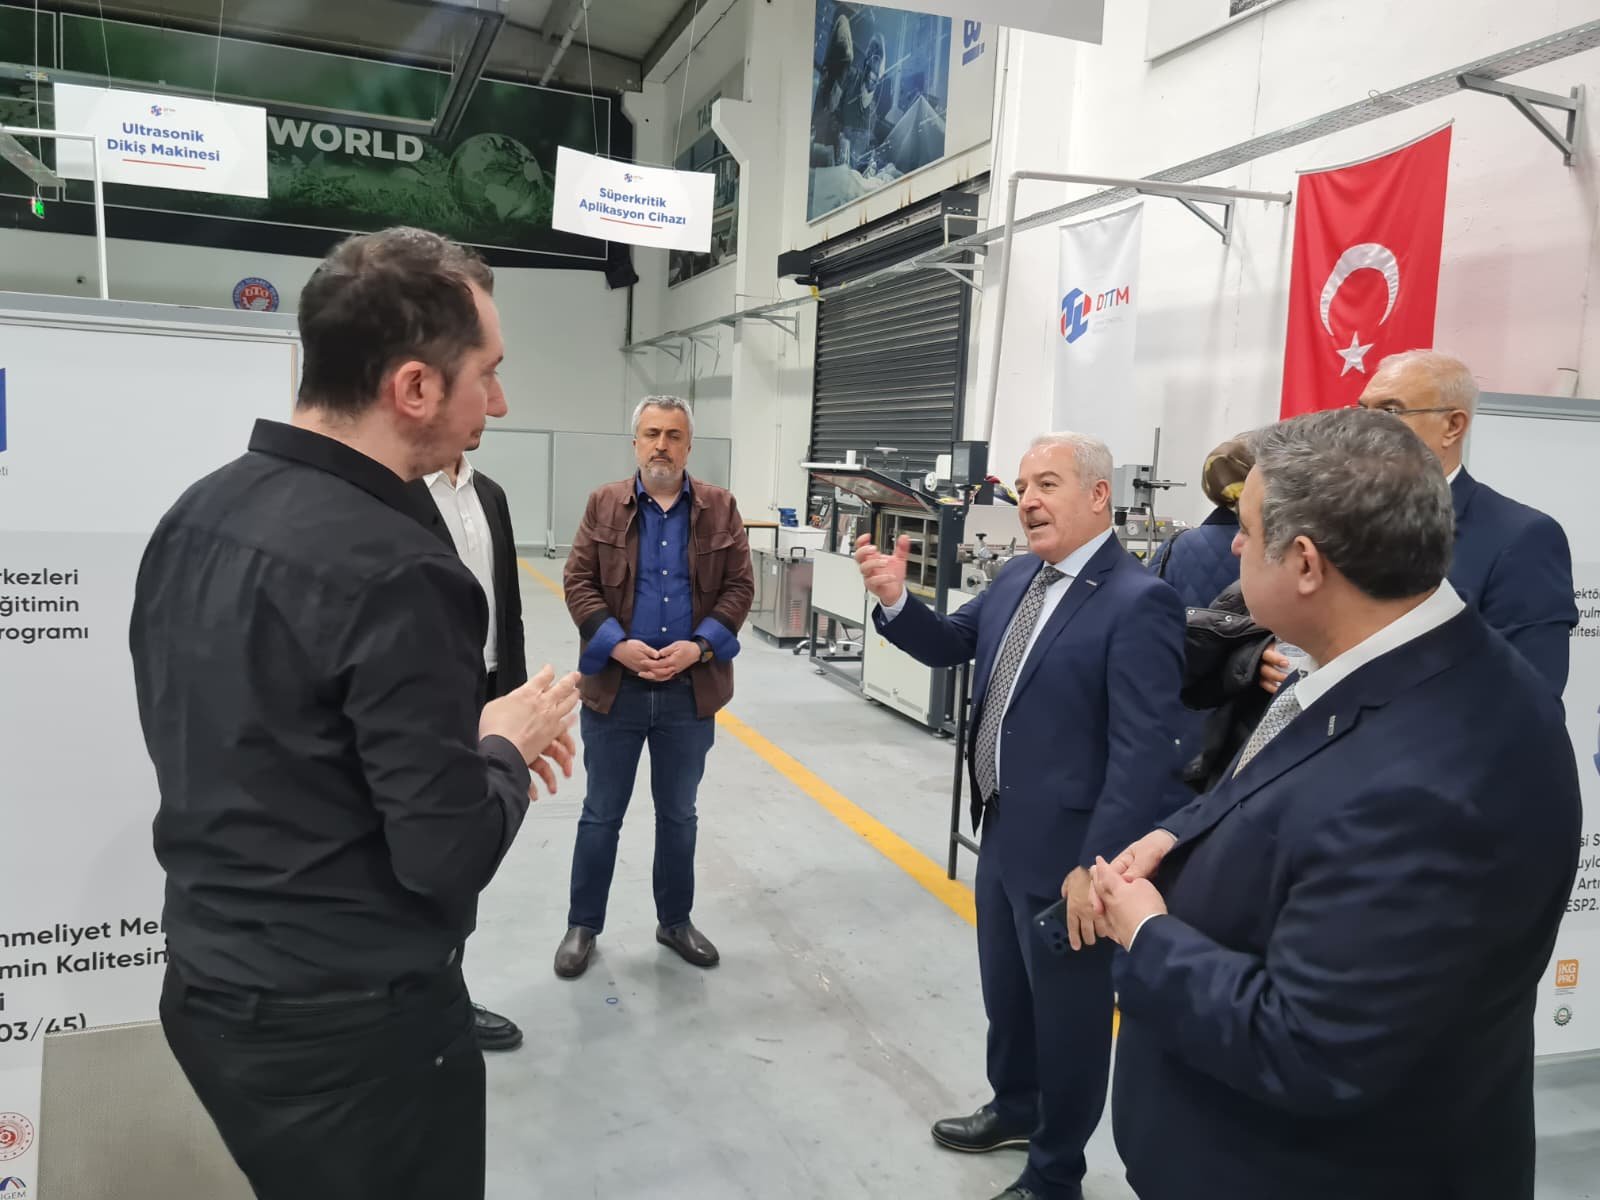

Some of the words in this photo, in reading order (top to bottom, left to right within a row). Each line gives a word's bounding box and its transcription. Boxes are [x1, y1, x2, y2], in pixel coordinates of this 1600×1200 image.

[122, 122, 204, 142] Ultrasonik
[267, 116, 424, 163] WORLD
[107, 138, 146, 155] Dikiş
[151, 143, 220, 161] Makinesi
[600, 187, 667, 208] Süperkritik
[579, 198, 645, 220] Aplikasyon
[648, 211, 686, 225] Cihazı
[0, 595, 79, 617] ğitimin
